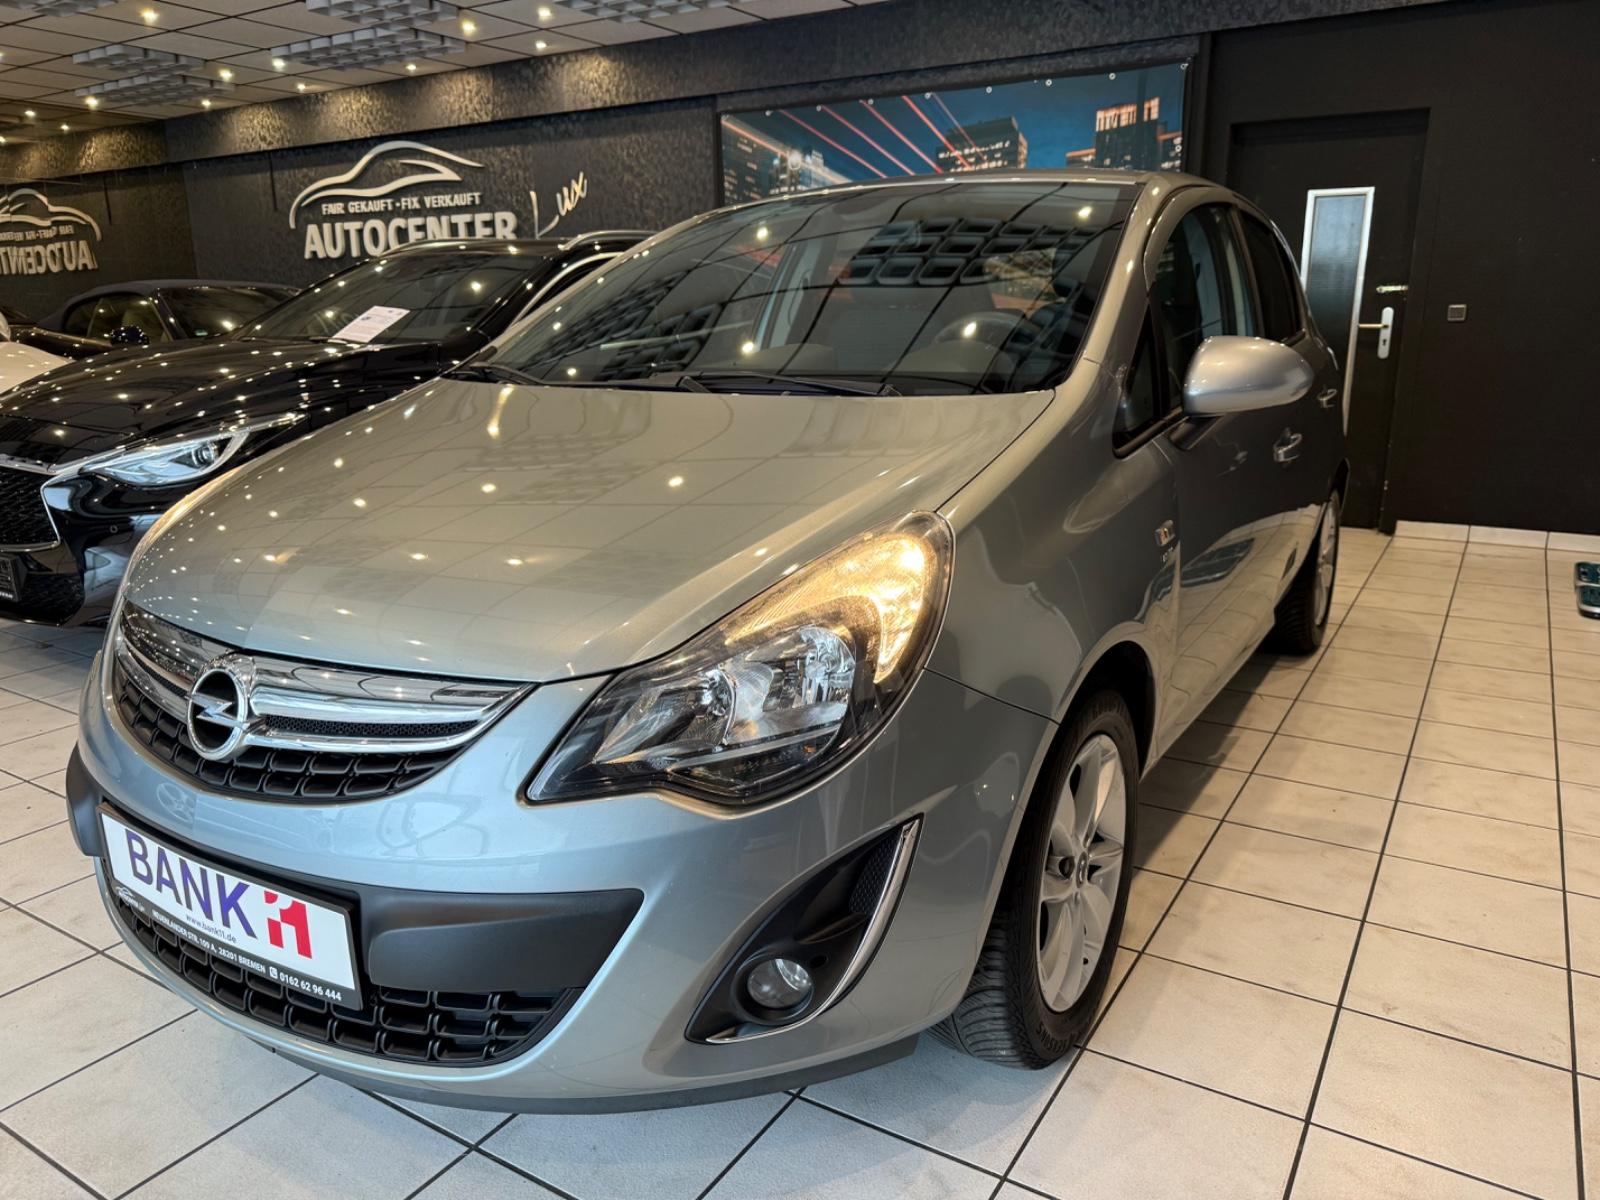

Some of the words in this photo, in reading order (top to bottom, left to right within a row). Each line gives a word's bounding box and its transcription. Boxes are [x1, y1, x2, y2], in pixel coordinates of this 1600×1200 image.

[321, 203, 346, 215] FAIR
[348, 199, 394, 213] GEKAUFT
[401, 196, 421, 210] FIX
[424, 192, 481, 208] VERKAUFT
[529, 171, 587, 239] Lux
[304, 211, 518, 260] AUTOCENTER
[125, 828, 258, 939] BANK
[219, 947, 237, 961] 28201
[239, 954, 266, 973] BREMEN
[280, 972, 299, 988] 0162
[300, 980, 311, 992] 62
[312, 984, 323, 995] 96
[325, 988, 342, 1001] 444
